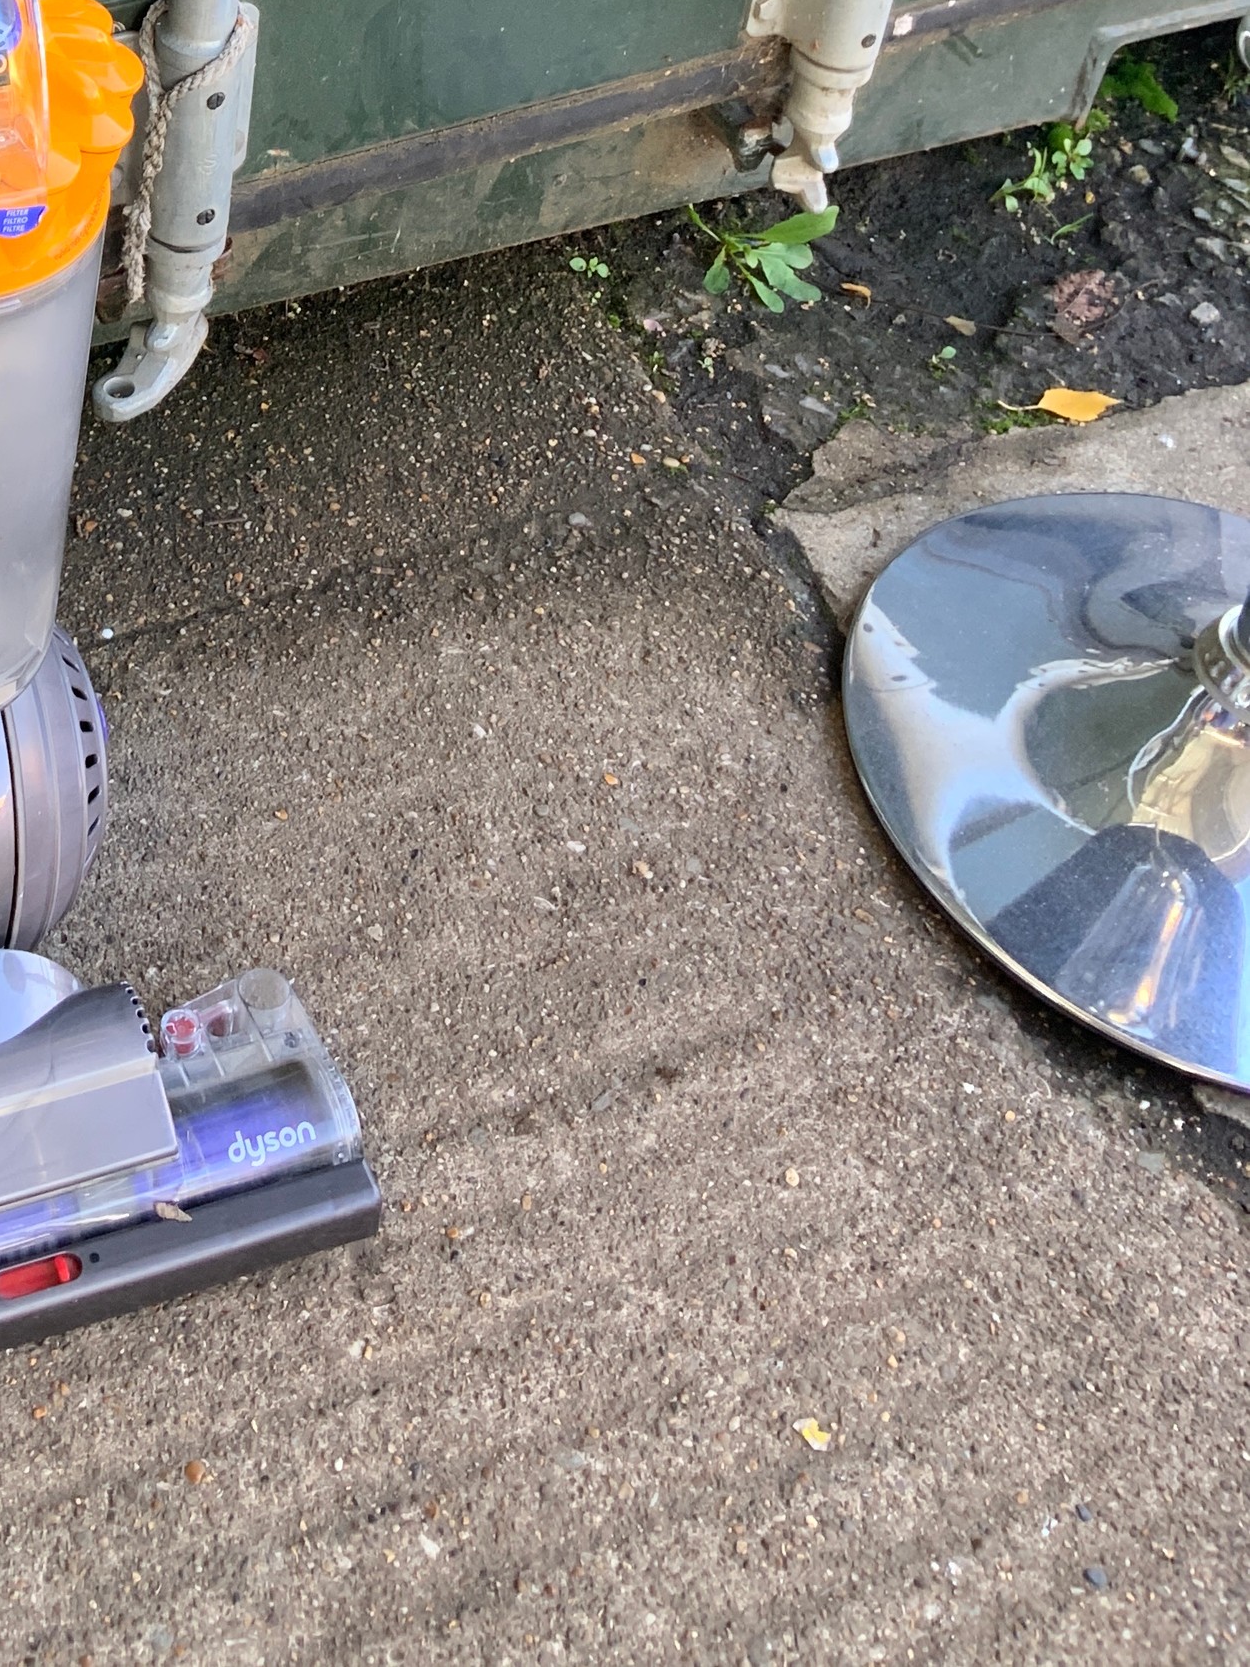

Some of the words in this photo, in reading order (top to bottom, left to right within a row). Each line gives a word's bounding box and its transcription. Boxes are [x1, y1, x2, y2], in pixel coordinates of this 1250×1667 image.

[6, 209, 29, 217] FILTER
[3, 217, 28, 225] FILTRO
[2, 224, 26, 233] FILTRE
[228, 1121, 317, 1166] dyson
